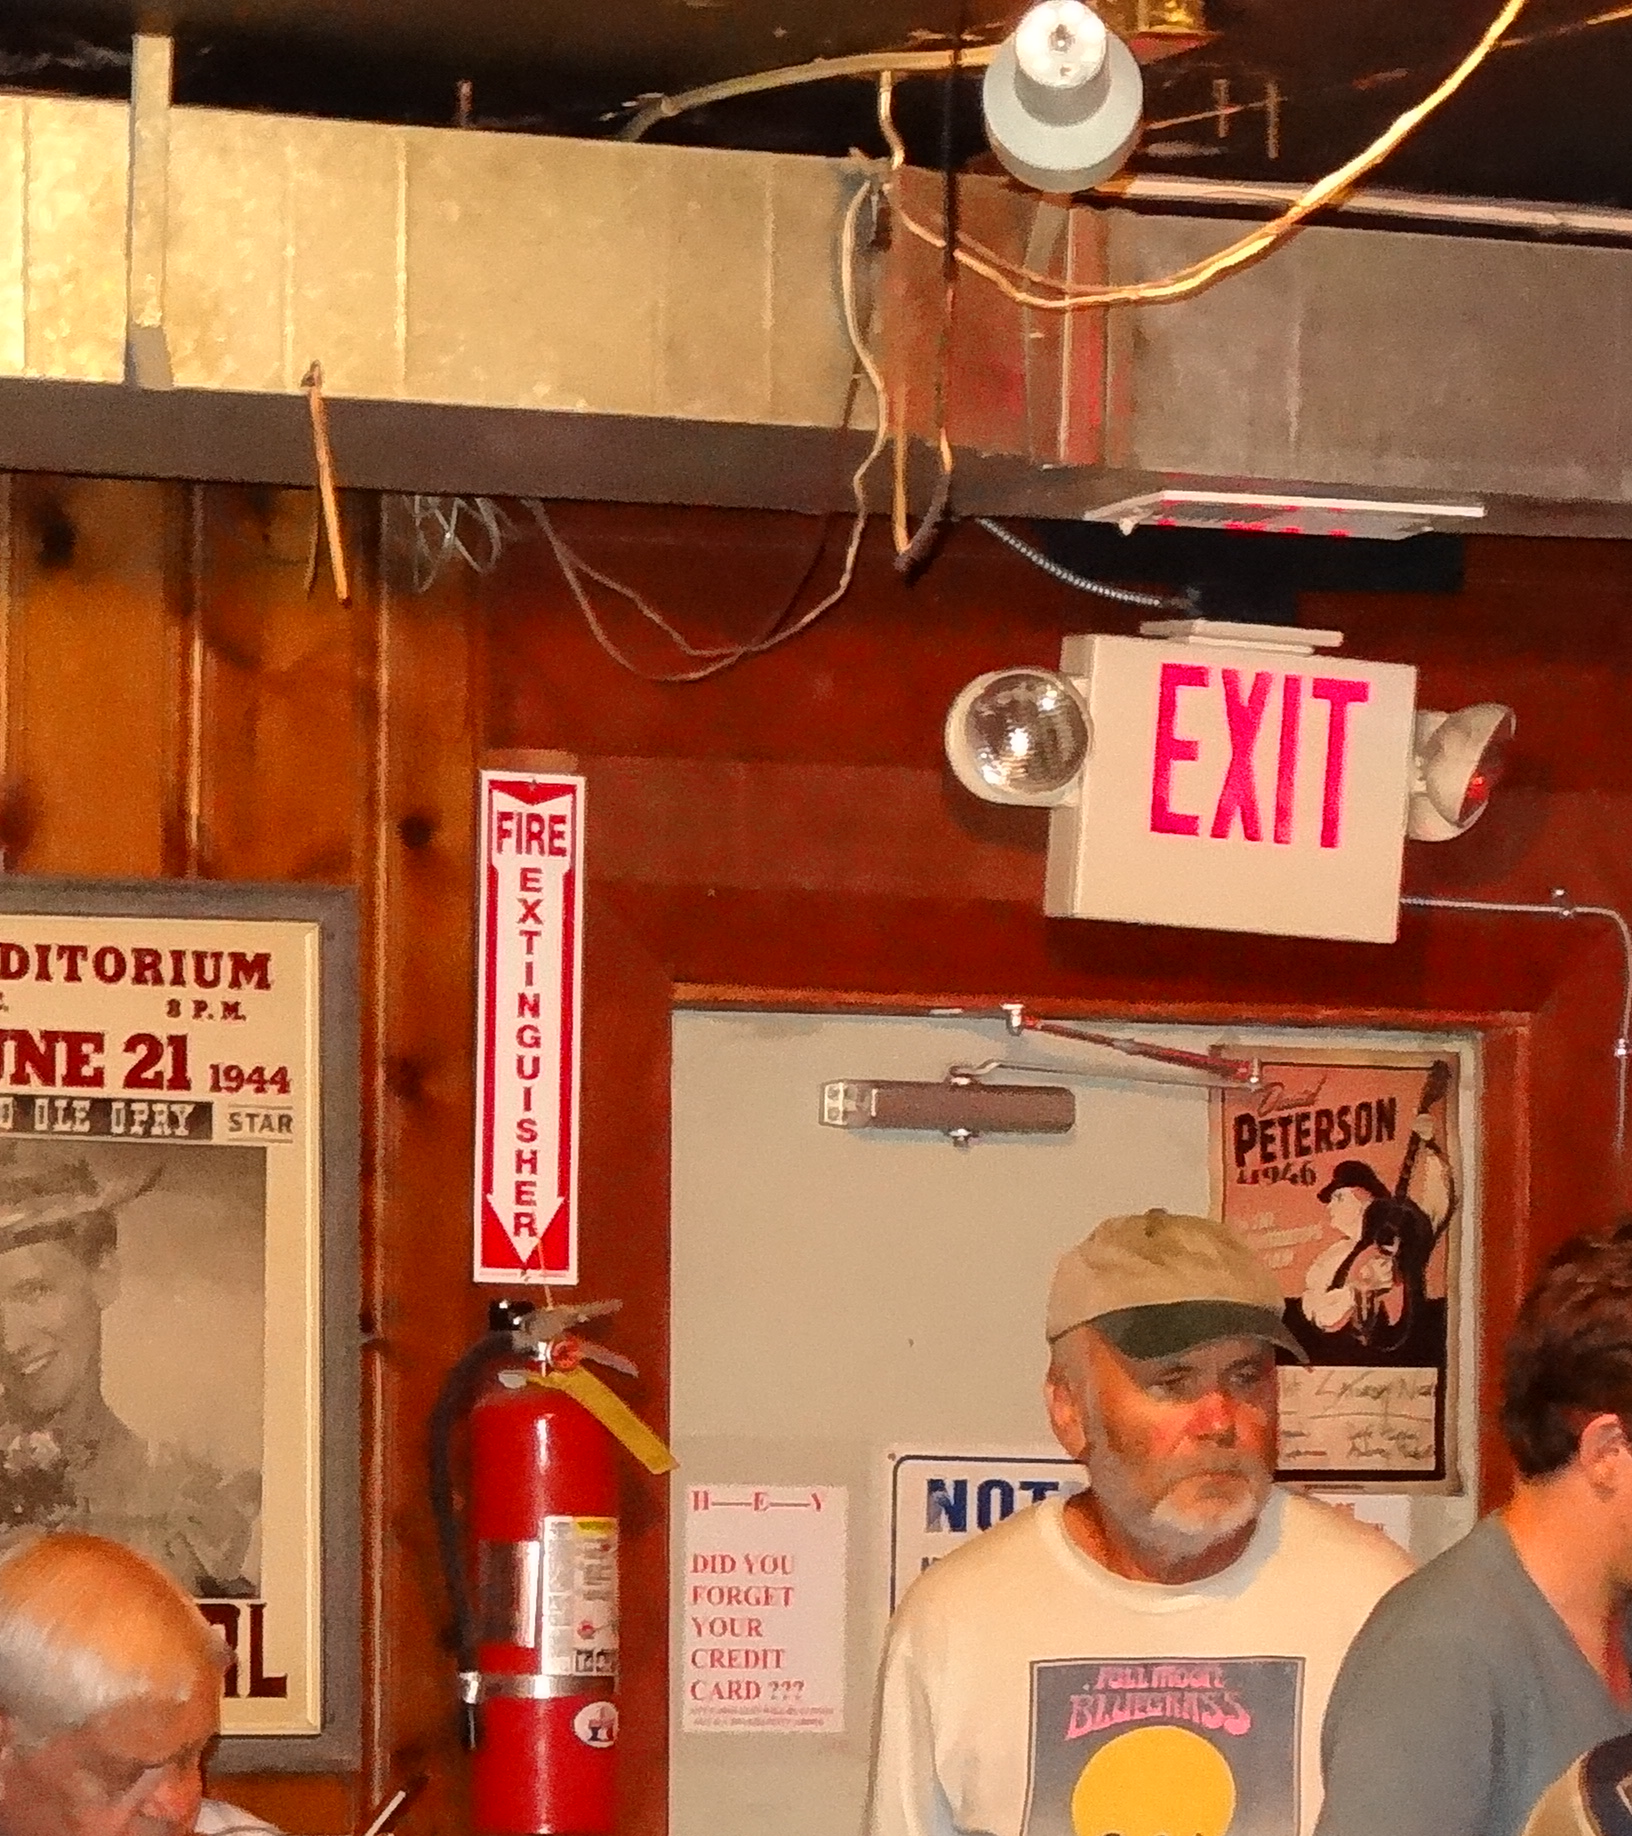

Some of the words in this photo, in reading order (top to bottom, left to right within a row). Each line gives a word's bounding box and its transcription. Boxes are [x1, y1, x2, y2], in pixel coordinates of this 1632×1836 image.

[1150, 662, 1369, 849] EXIT
[496, 811, 568, 858] FIRE
[123, 1032, 192, 1092] 21
[208, 1063, 292, 1095] 1944
[512, 867, 544, 1239] EXTINGUISHER
[228, 1111, 293, 1135] STAR
[1234, 1097, 1397, 1168] PETERSON
[692, 1554, 737, 1575] DID
[744, 1554, 794, 1576] YOU
[692, 1586, 795, 1608] FORGET
[692, 1617, 764, 1638] YOUR
[691, 1648, 786, 1671] CREDIT
[690, 1679, 762, 1702] CARD
[1065, 1690, 1252, 1740] BLUEGRASS
